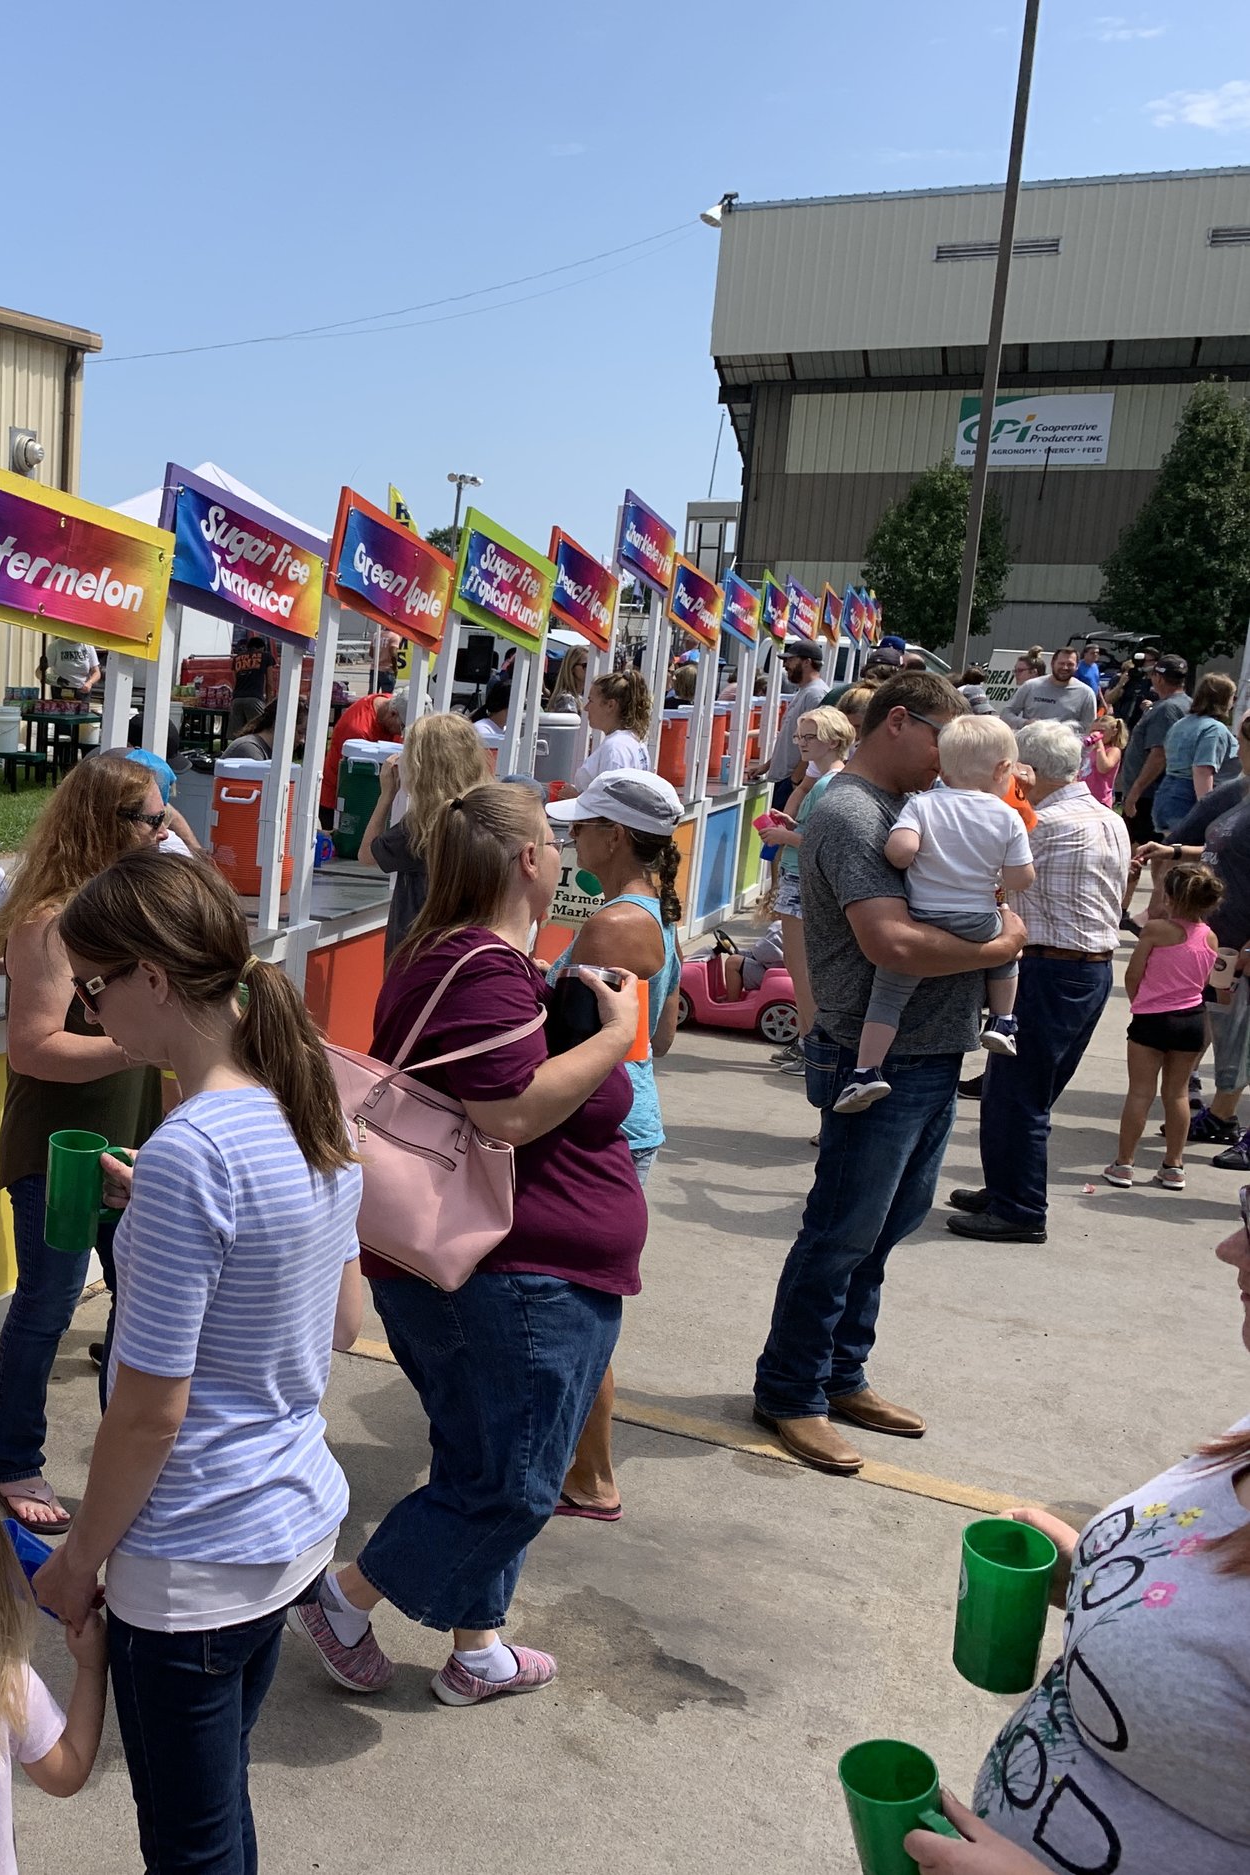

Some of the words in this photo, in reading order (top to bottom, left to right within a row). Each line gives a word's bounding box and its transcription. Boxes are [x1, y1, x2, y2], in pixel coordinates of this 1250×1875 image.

[1035, 423, 1098, 433] Cooperative
[991, 448, 1037, 456] AGRONOMY
[200, 505, 276, 566] Sugar
[270, 543, 311, 586] Free
[209, 551, 295, 619] Jamaica
[353, 542, 408, 597] Green
[402, 576, 442, 618] Apple
[464, 565, 513, 614] Tropical
[480, 543, 521, 588] Sugar
[516, 567, 542, 599] Free
[556, 563, 593, 606] Peach
[235, 658, 261, 671] ONE
[558, 867, 572, 887] I
